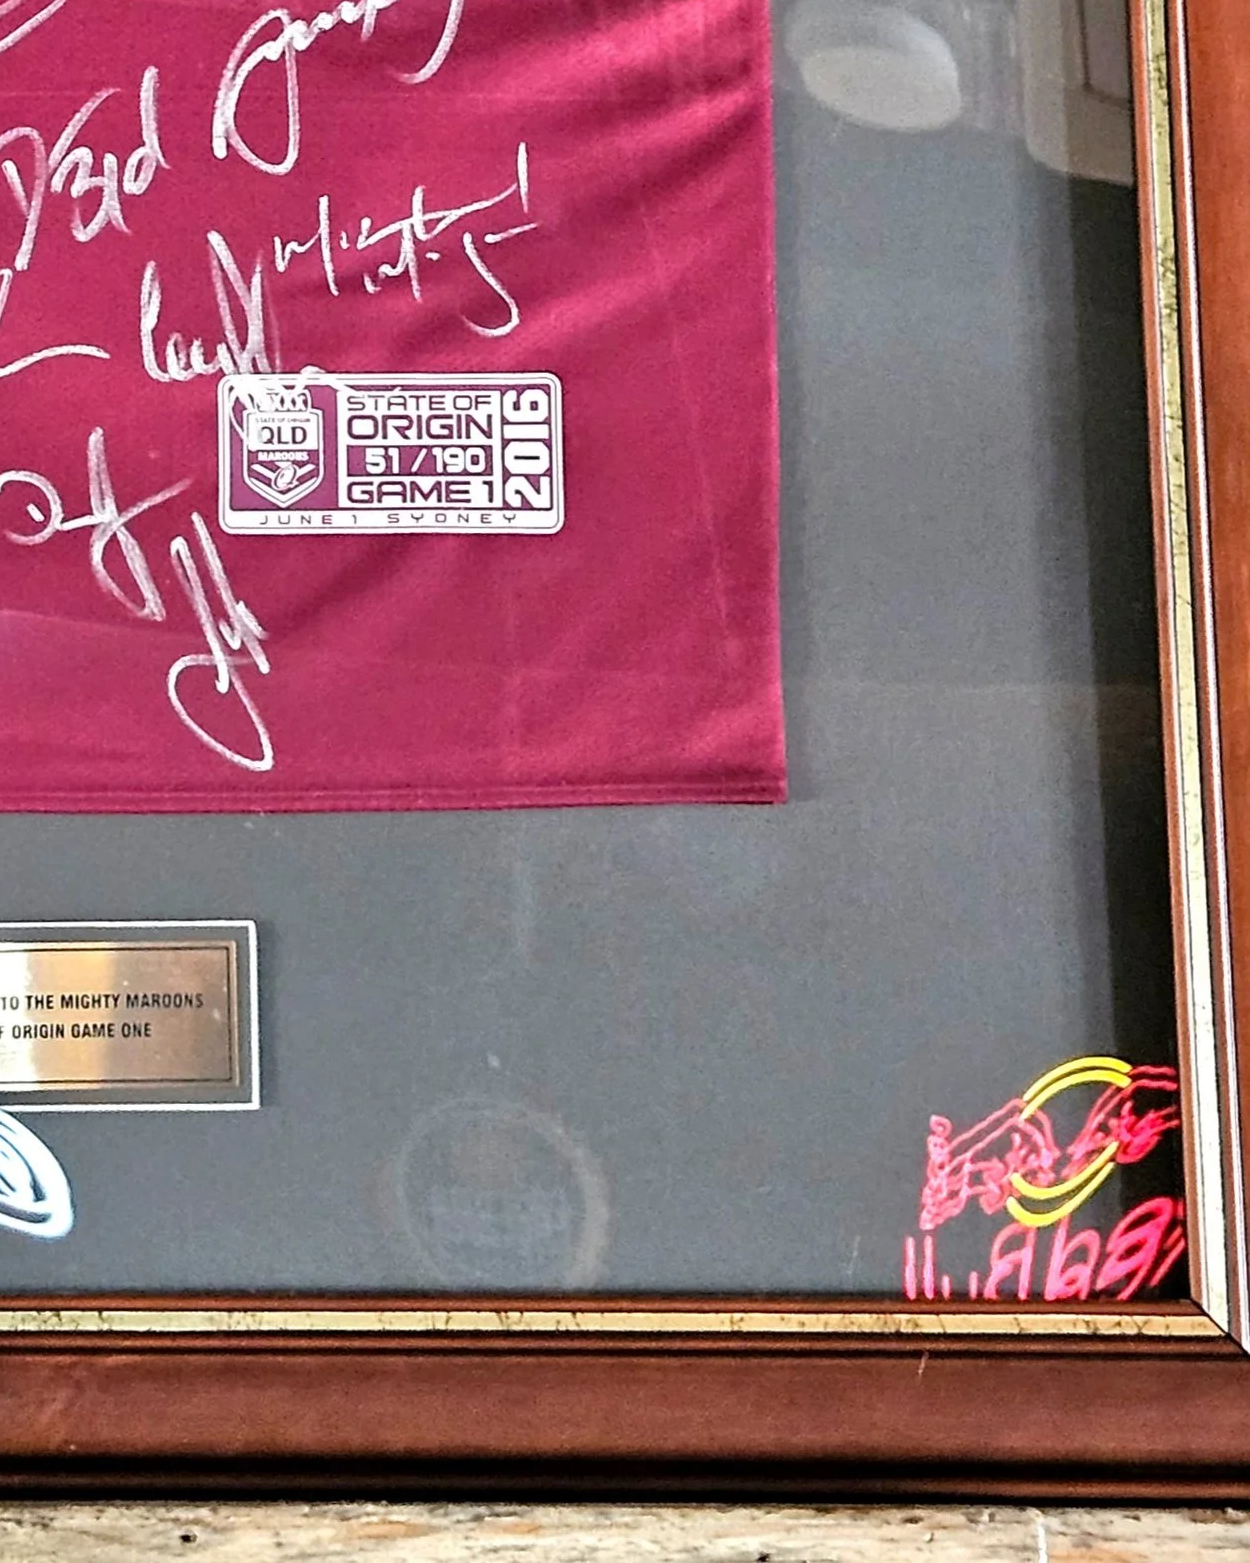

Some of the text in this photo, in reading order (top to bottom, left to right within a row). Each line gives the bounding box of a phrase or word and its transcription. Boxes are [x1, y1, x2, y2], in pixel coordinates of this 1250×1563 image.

[347, 394, 491, 412] STATE OF
[258, 425, 307, 445] QLD
[347, 413, 493, 441] ORIGIN
[504, 388, 551, 509] 2016
[347, 480, 494, 505] GAME 1
[259, 514, 333, 525] JUNE
[387, 512, 517, 524] SYDNEY
[26, 994, 54, 1010] THE
[60, 992, 120, 1010] MIGHTY
[125, 992, 204, 1009] MAROONS
[12, 1023, 65, 1038] ORIGIN
[72, 1022, 115, 1038] GAME
[121, 1021, 153, 1037] ONE
